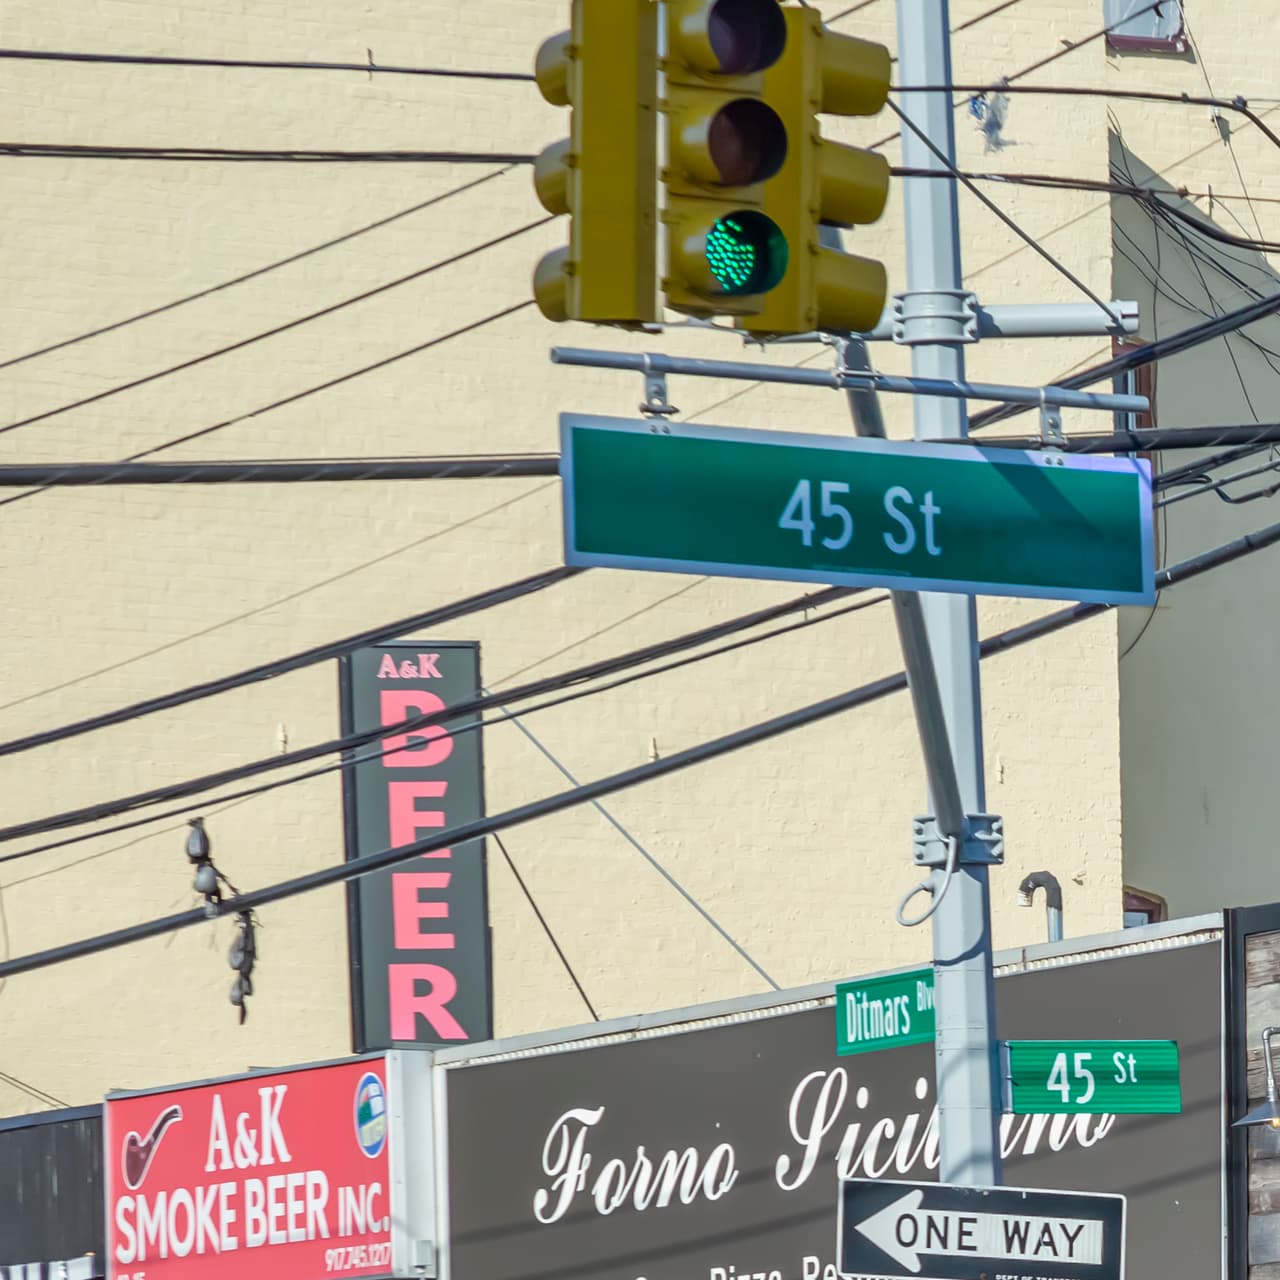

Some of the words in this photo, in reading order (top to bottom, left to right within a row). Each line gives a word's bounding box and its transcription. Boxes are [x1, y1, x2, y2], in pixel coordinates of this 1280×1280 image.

[778, 478, 854, 551] 45
[883, 485, 942, 557] St
[377, 653, 443, 679] A&K
[379, 689, 469, 1040] BEER
[846, 992, 910, 1043] Ditmars
[916, 980, 935, 1012] Blv
[1047, 1052, 1095, 1104] 45
[1112, 1051, 1138, 1084] St
[204, 1084, 292, 1173] A&K
[533, 1106, 739, 1224] Forno
[115, 1181, 238, 1265] SMOKE
[245, 1170, 329, 1249] BEER
[337, 1182, 391, 1237] INC.
[895, 1213, 978, 1252] ONE
[1003, 1219, 1085, 1258] WAY
